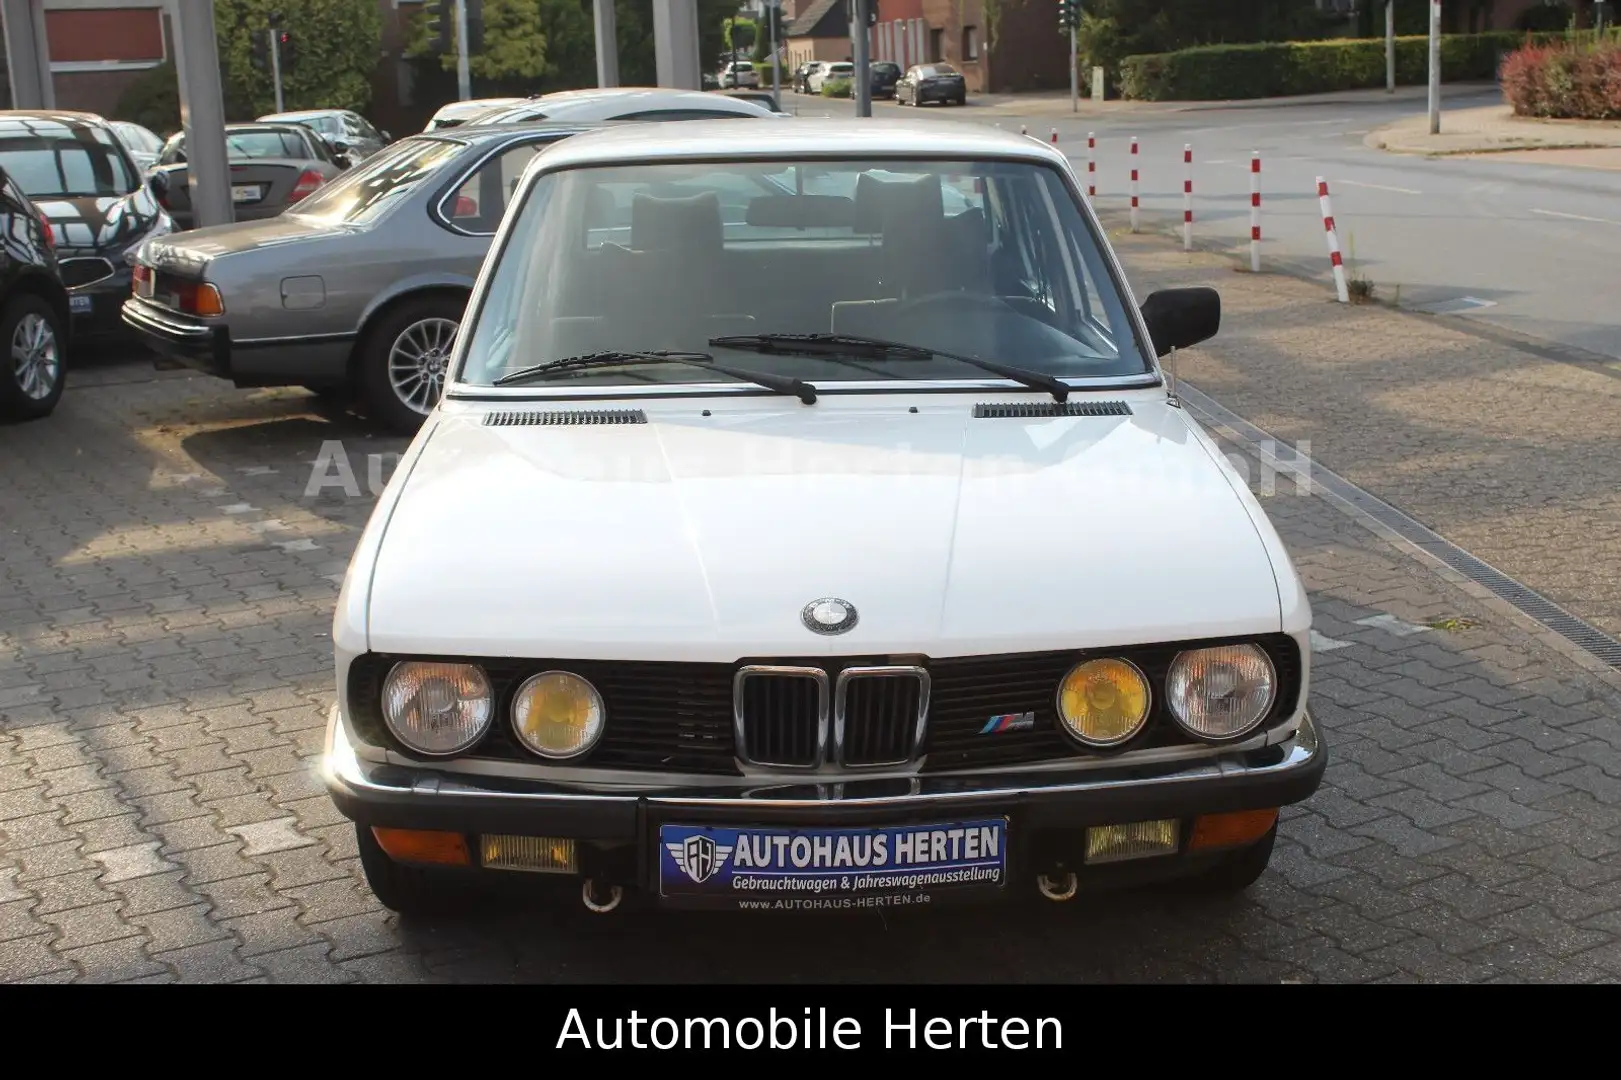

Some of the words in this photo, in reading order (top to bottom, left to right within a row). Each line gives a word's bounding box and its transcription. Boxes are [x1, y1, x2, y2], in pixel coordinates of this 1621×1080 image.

[734, 833, 888, 868] AUTOHAUS
[894, 825, 999, 865] HERTEN
[733, 875, 837, 893] Gebrauchtwagen
[841, 875, 850, 889] &
[852, 866, 1000, 892] Jahreswagenausstellung
[738, 893, 931, 909] www.AUTOHAUS-HERTEN.de
